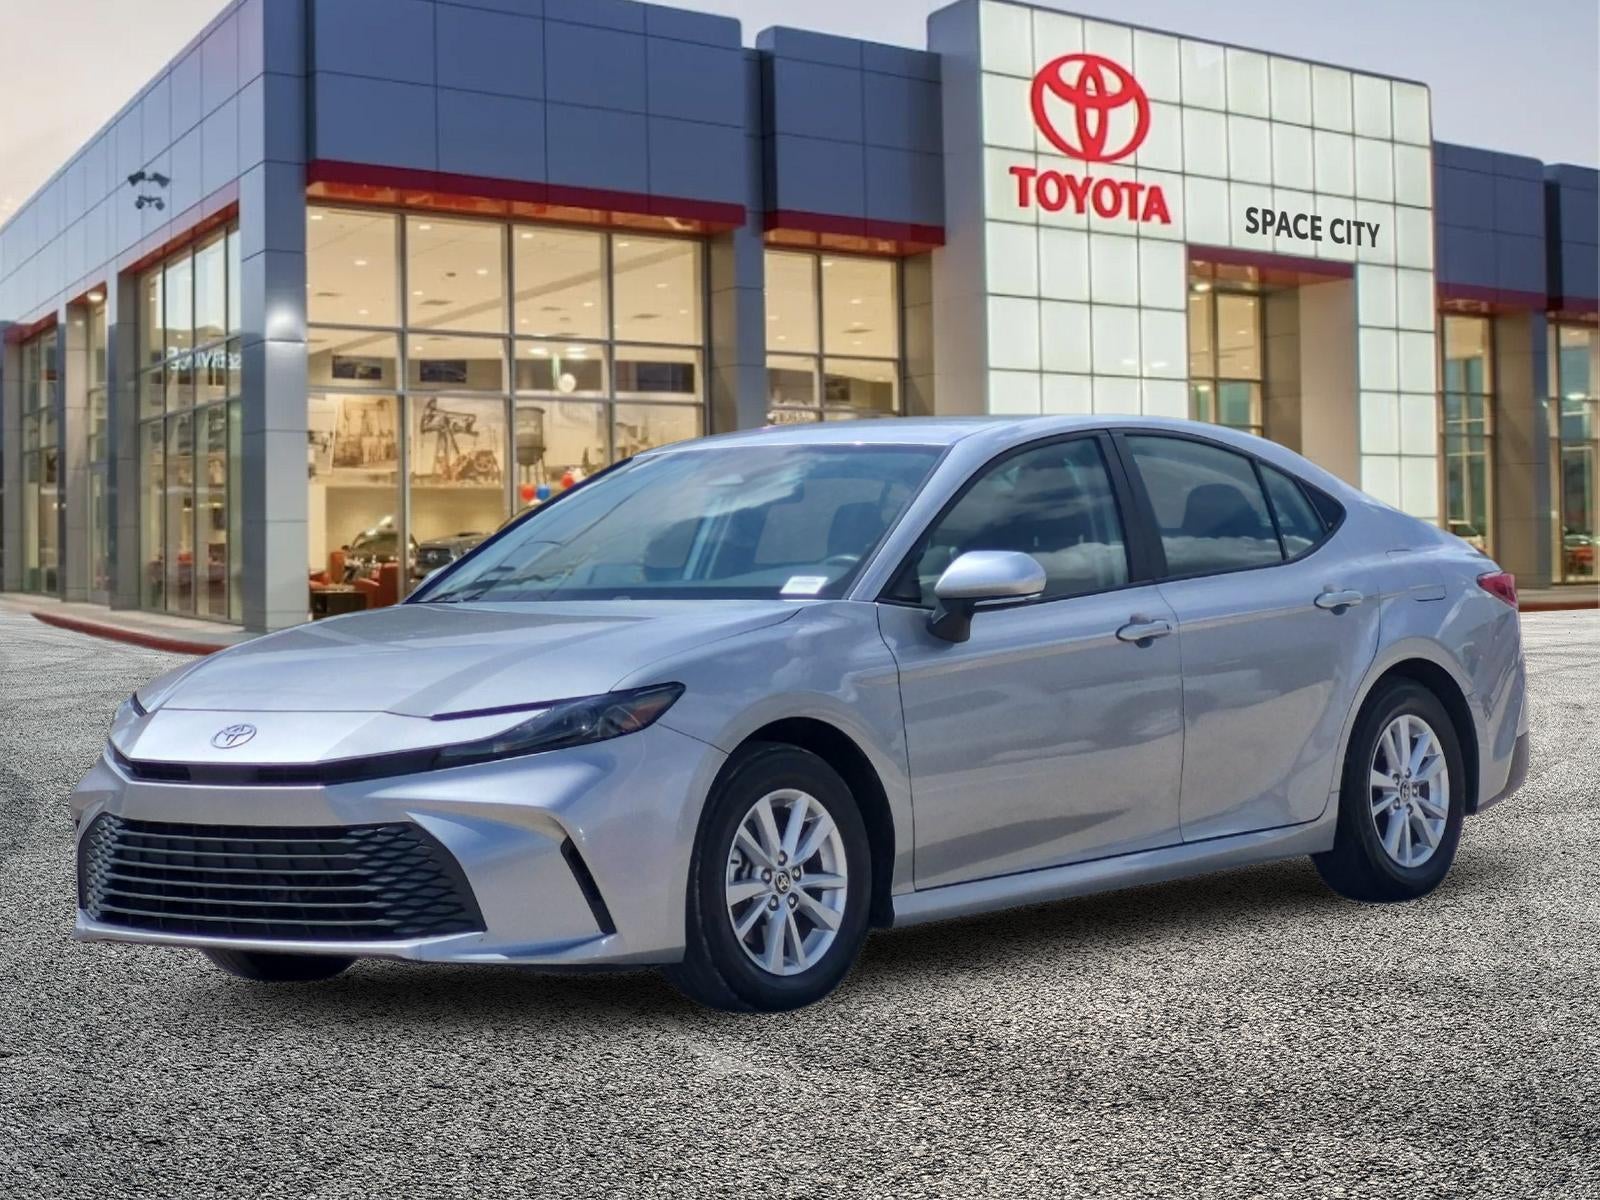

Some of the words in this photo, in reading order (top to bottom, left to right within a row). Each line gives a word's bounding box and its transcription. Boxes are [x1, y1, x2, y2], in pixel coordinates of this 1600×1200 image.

[1009, 166, 1171, 225] TOYOTA
[1245, 206, 1323, 242] SPACE
[1329, 218, 1380, 248] CITY
